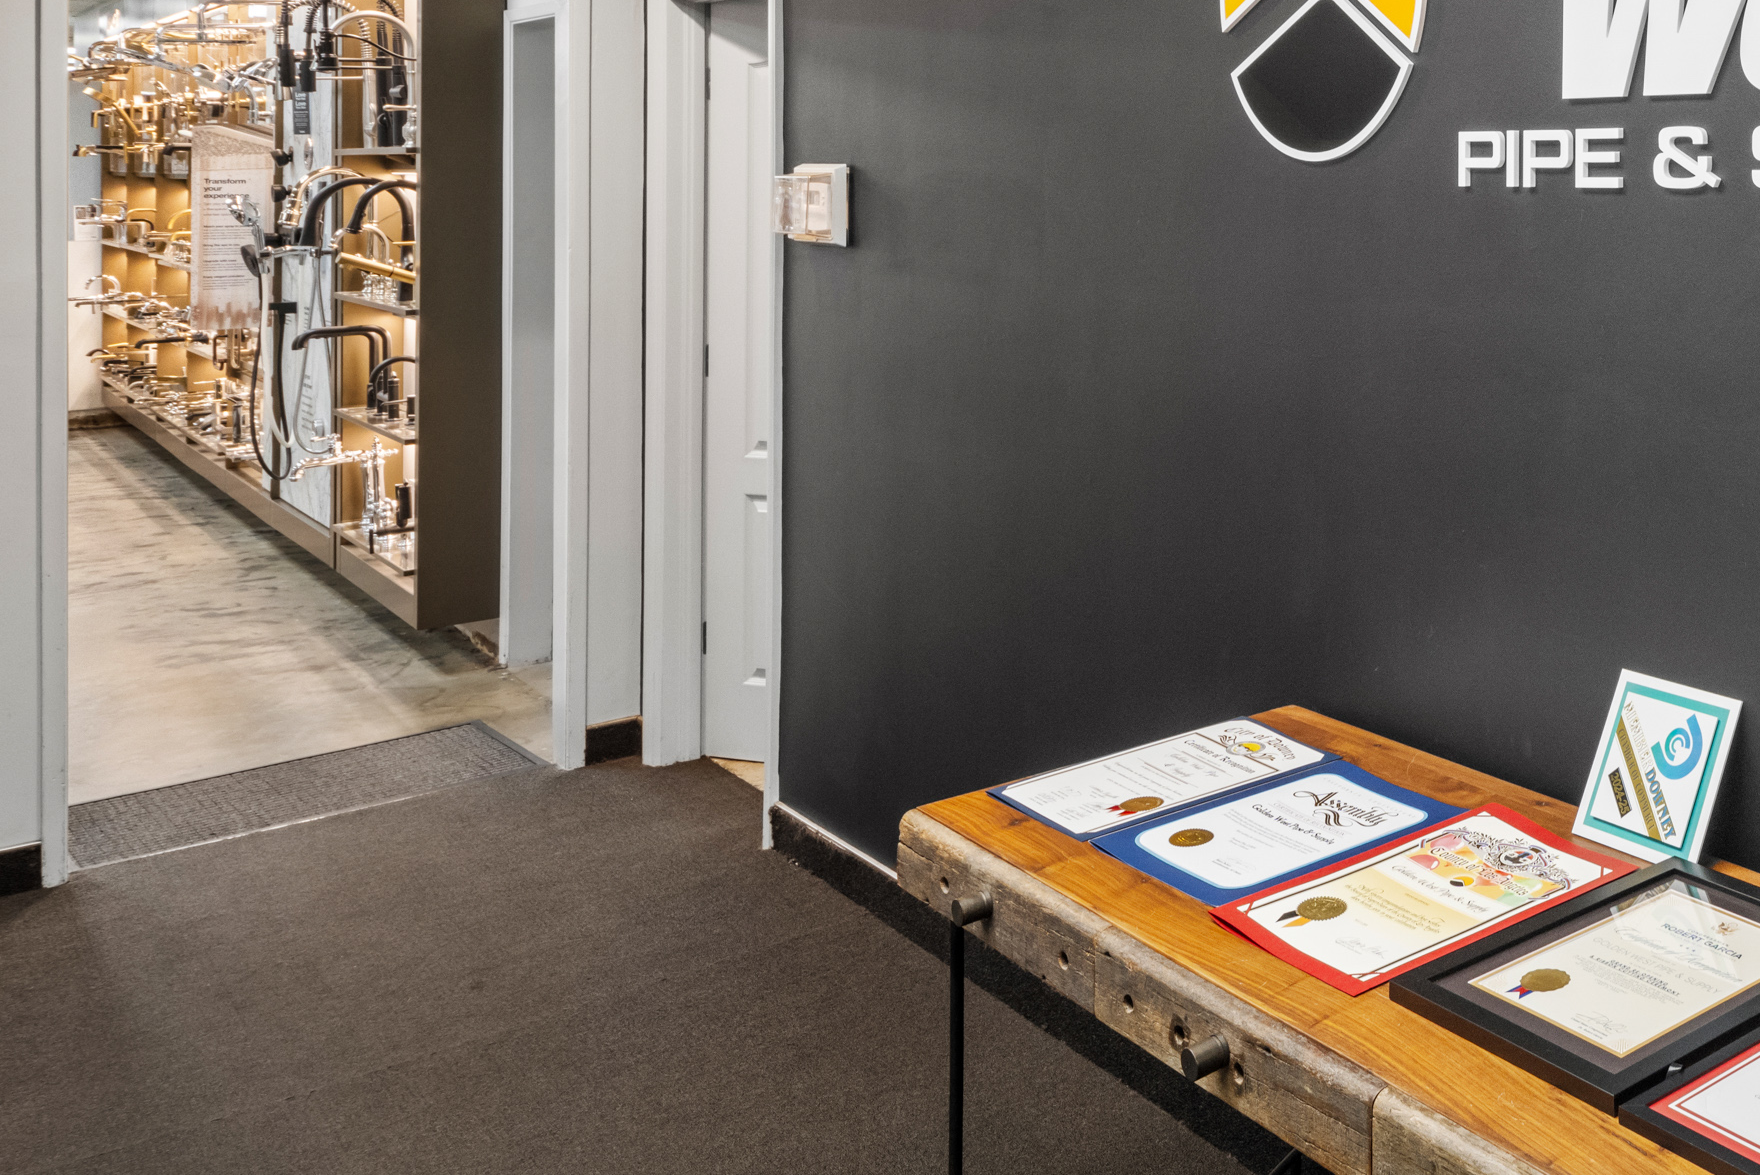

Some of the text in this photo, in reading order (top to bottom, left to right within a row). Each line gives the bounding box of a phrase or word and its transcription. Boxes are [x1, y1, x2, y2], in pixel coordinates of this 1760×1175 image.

[1457, 127, 1624, 190] PIPE
[1653, 125, 1721, 188] &
[1224, 727, 1255, 736] City
[1610, 771, 1630, 815] 2024-25
[1618, 728, 1655, 830] CHAMBER OF COMMERCE
[1624, 701, 1676, 840] MEMBER DOWNEY
[1293, 790, 1399, 827] Assembly
[1430, 847, 1470, 868] County
[1478, 868, 1502, 879] Los
[1494, 876, 1528, 896] Angeles
[1593, 937, 1631, 955] GOLDEN
[1630, 954, 1656, 966] WEST
[1654, 963, 1677, 975] PIPE
[1684, 977, 1720, 994] SUPPLY
[1661, 923, 1703, 942] ROBERT
[1704, 941, 1743, 960] GARCIA
